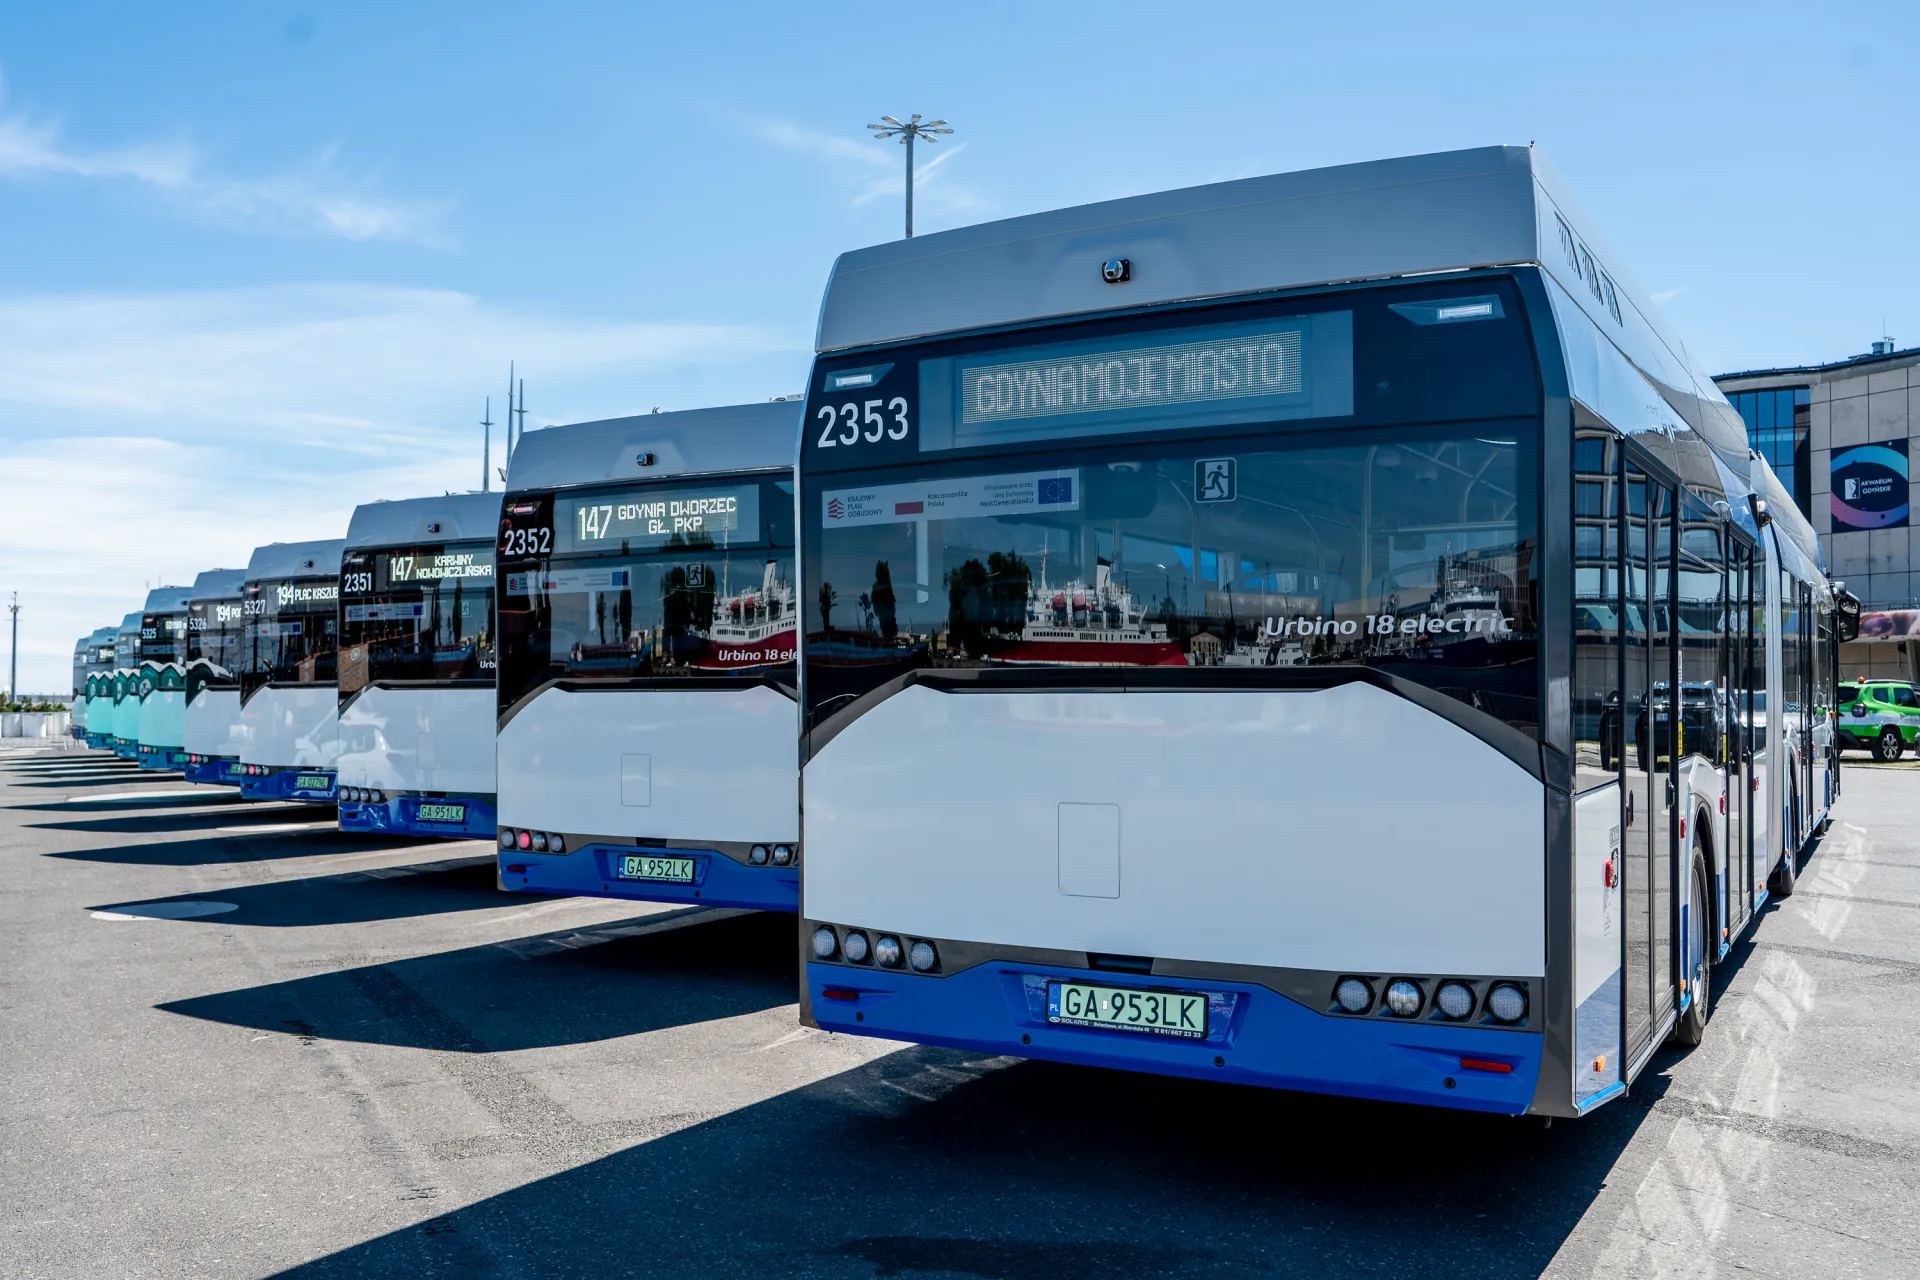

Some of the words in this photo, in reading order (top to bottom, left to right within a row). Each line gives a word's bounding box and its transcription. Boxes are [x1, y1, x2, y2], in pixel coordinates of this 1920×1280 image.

[976, 365, 1078, 414] GDYNIA
[1082, 355, 1161, 404] MOJE
[1166, 343, 1284, 396] MIASTO
[817, 395, 910, 449] 2353
[1861, 478, 1893, 487] AKWARIUM
[1862, 485, 1892, 495] GDYŃSKIE
[847, 494, 876, 503] KRAJOWY
[927, 490, 968, 500] Rzeczpospolita
[980, 498, 1034, 507] NextGenerationEU
[578, 504, 613, 540] 147
[617, 501, 666, 520] GDYNIA
[670, 496, 736, 517] DWORZEC
[847, 508, 884, 518] ODBUDOWY
[648, 519, 670, 535] GŁ.
[674, 516, 703, 533] PKP
[504, 526, 551, 556] 2352
[390, 556, 414, 582] 147
[434, 554, 474, 567] KARWINY
[416, 564, 492, 580] NOWOWICZLIŃSKA
[344, 572, 372, 593] 2351
[276, 586, 295, 606] 194
[294, 588, 312, 601] PLAC
[312, 586, 339, 600] KASZUB
[216, 605, 231, 622] 194
[244, 599, 266, 615] 5327
[189, 617, 207, 631] 5326
[1265, 615, 1358, 636] Urbino
[1365, 614, 1394, 635] 18
[1400, 612, 1515, 634] electric
[142, 628, 157, 640] 5325
[718, 649, 761, 661] Urbino
[764, 649, 778, 660] 18
[298, 777, 306, 786] GA
[421, 805, 433, 818] GA
[435, 806, 462, 819] 951LK
[626, 858, 643, 875] GA
[648, 859, 690, 878] 952LK
[1049, 1003, 1059, 1012] PL
[1065, 987, 1099, 1019] GA
[1110, 992, 1197, 1029] 953LK
[1060, 1018, 1089, 1026] SOLARIS
